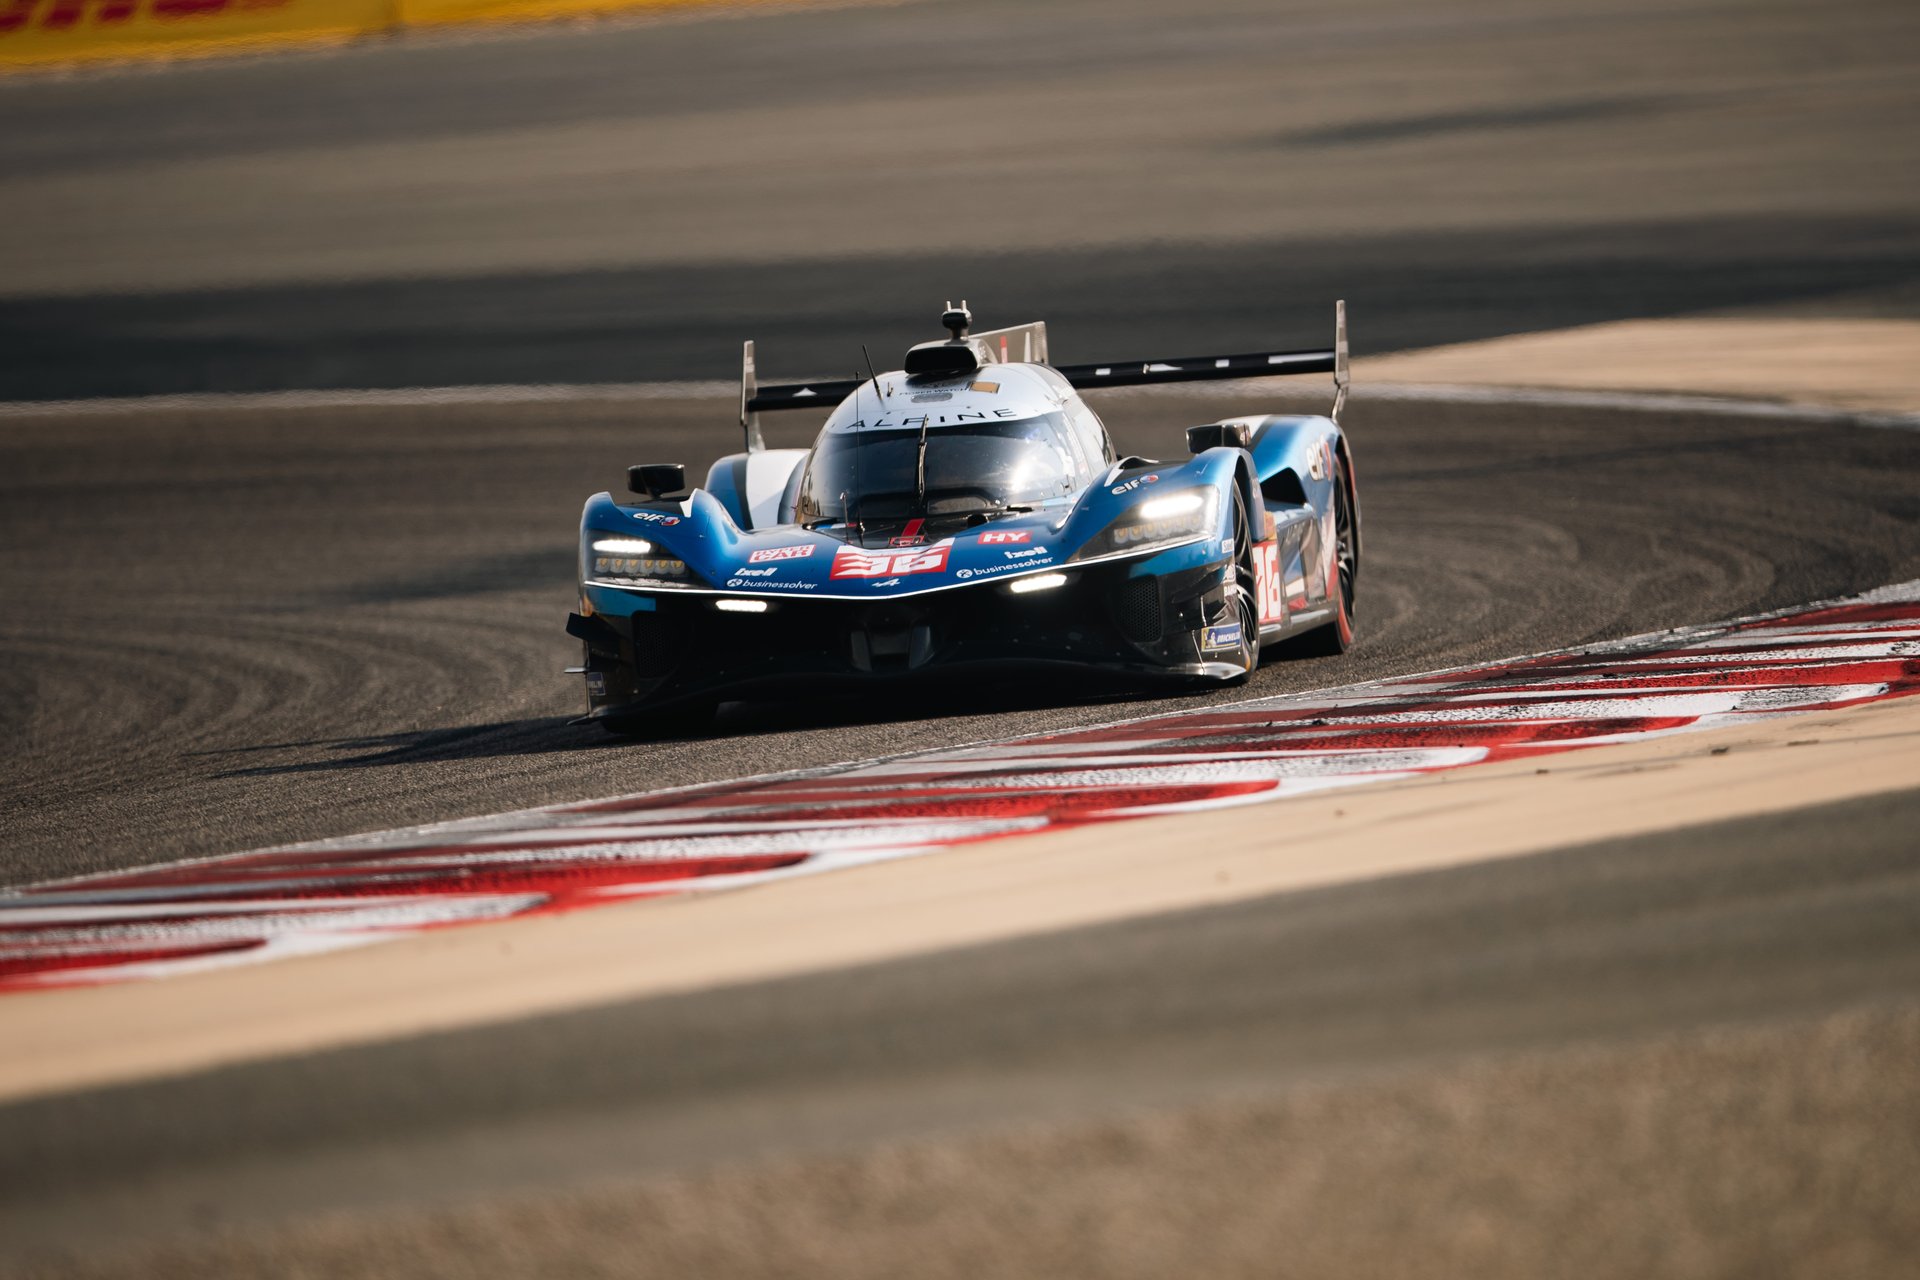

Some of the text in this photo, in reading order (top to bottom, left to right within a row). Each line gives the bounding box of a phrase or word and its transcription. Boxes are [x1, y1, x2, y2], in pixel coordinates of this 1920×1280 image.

[847, 408, 1017, 429] ALPINE
[1112, 479, 1141, 495] elf
[633, 512, 665, 521] elf
[982, 532, 1028, 544] HY
[835, 547, 943, 576] 36
[974, 556, 1055, 576] businessolver
[742, 580, 818, 590] businessolver
